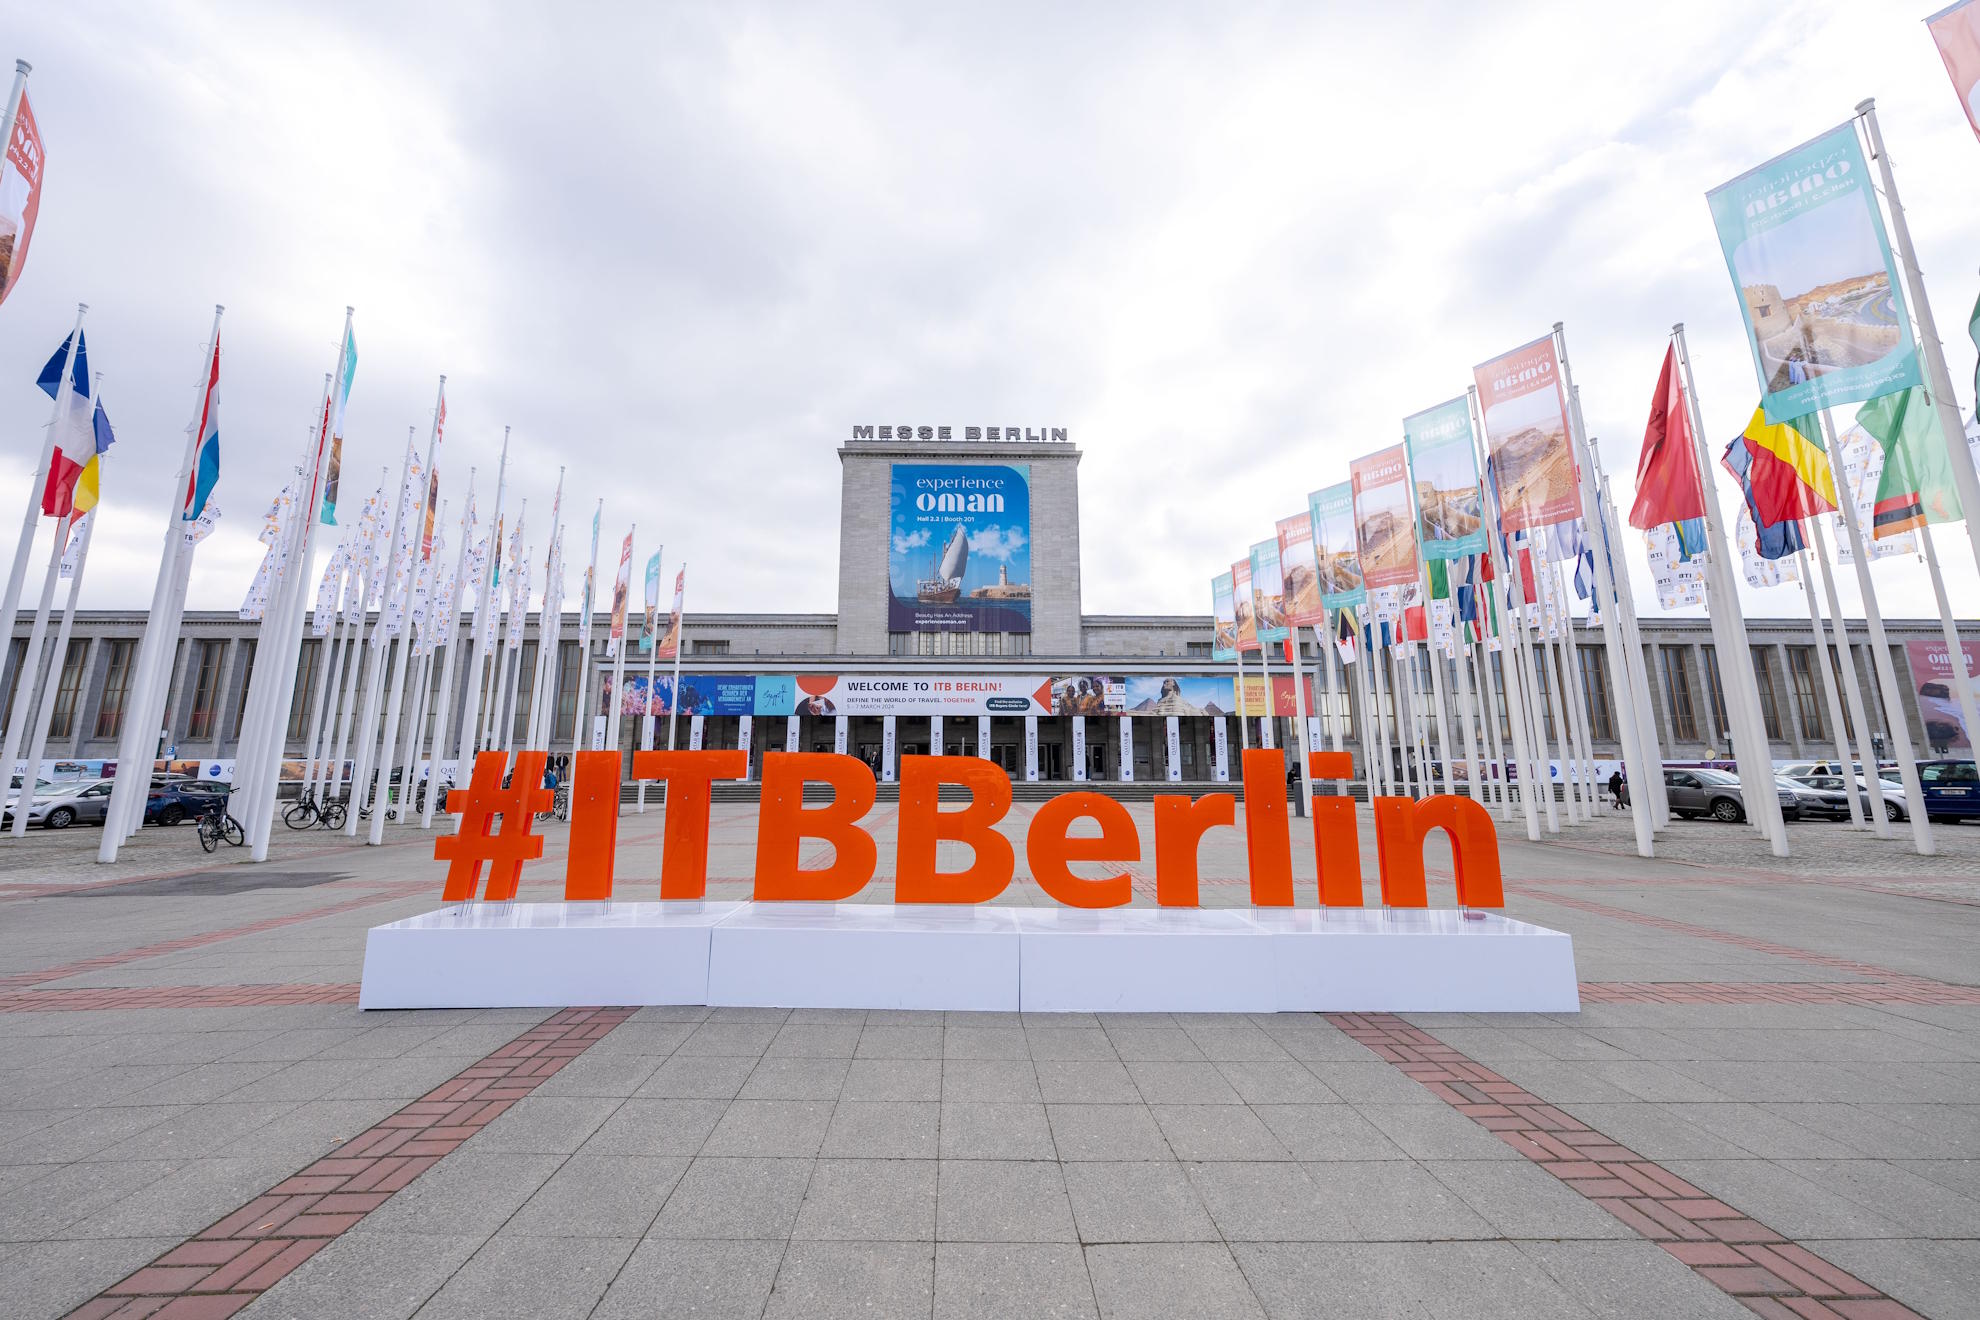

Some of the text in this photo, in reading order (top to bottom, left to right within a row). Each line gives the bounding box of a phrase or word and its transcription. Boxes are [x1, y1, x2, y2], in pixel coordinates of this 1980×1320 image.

[853, 425, 1068, 441] MESSE BERLIN
[916, 476, 1004, 492] experience
[916, 493, 1005, 512] oman
[1928, 654, 1973, 664] omn
[848, 682, 1002, 691] WELCOME TO ITB BERLIN!
[434, 749, 1505, 908] #ITBBerlin
